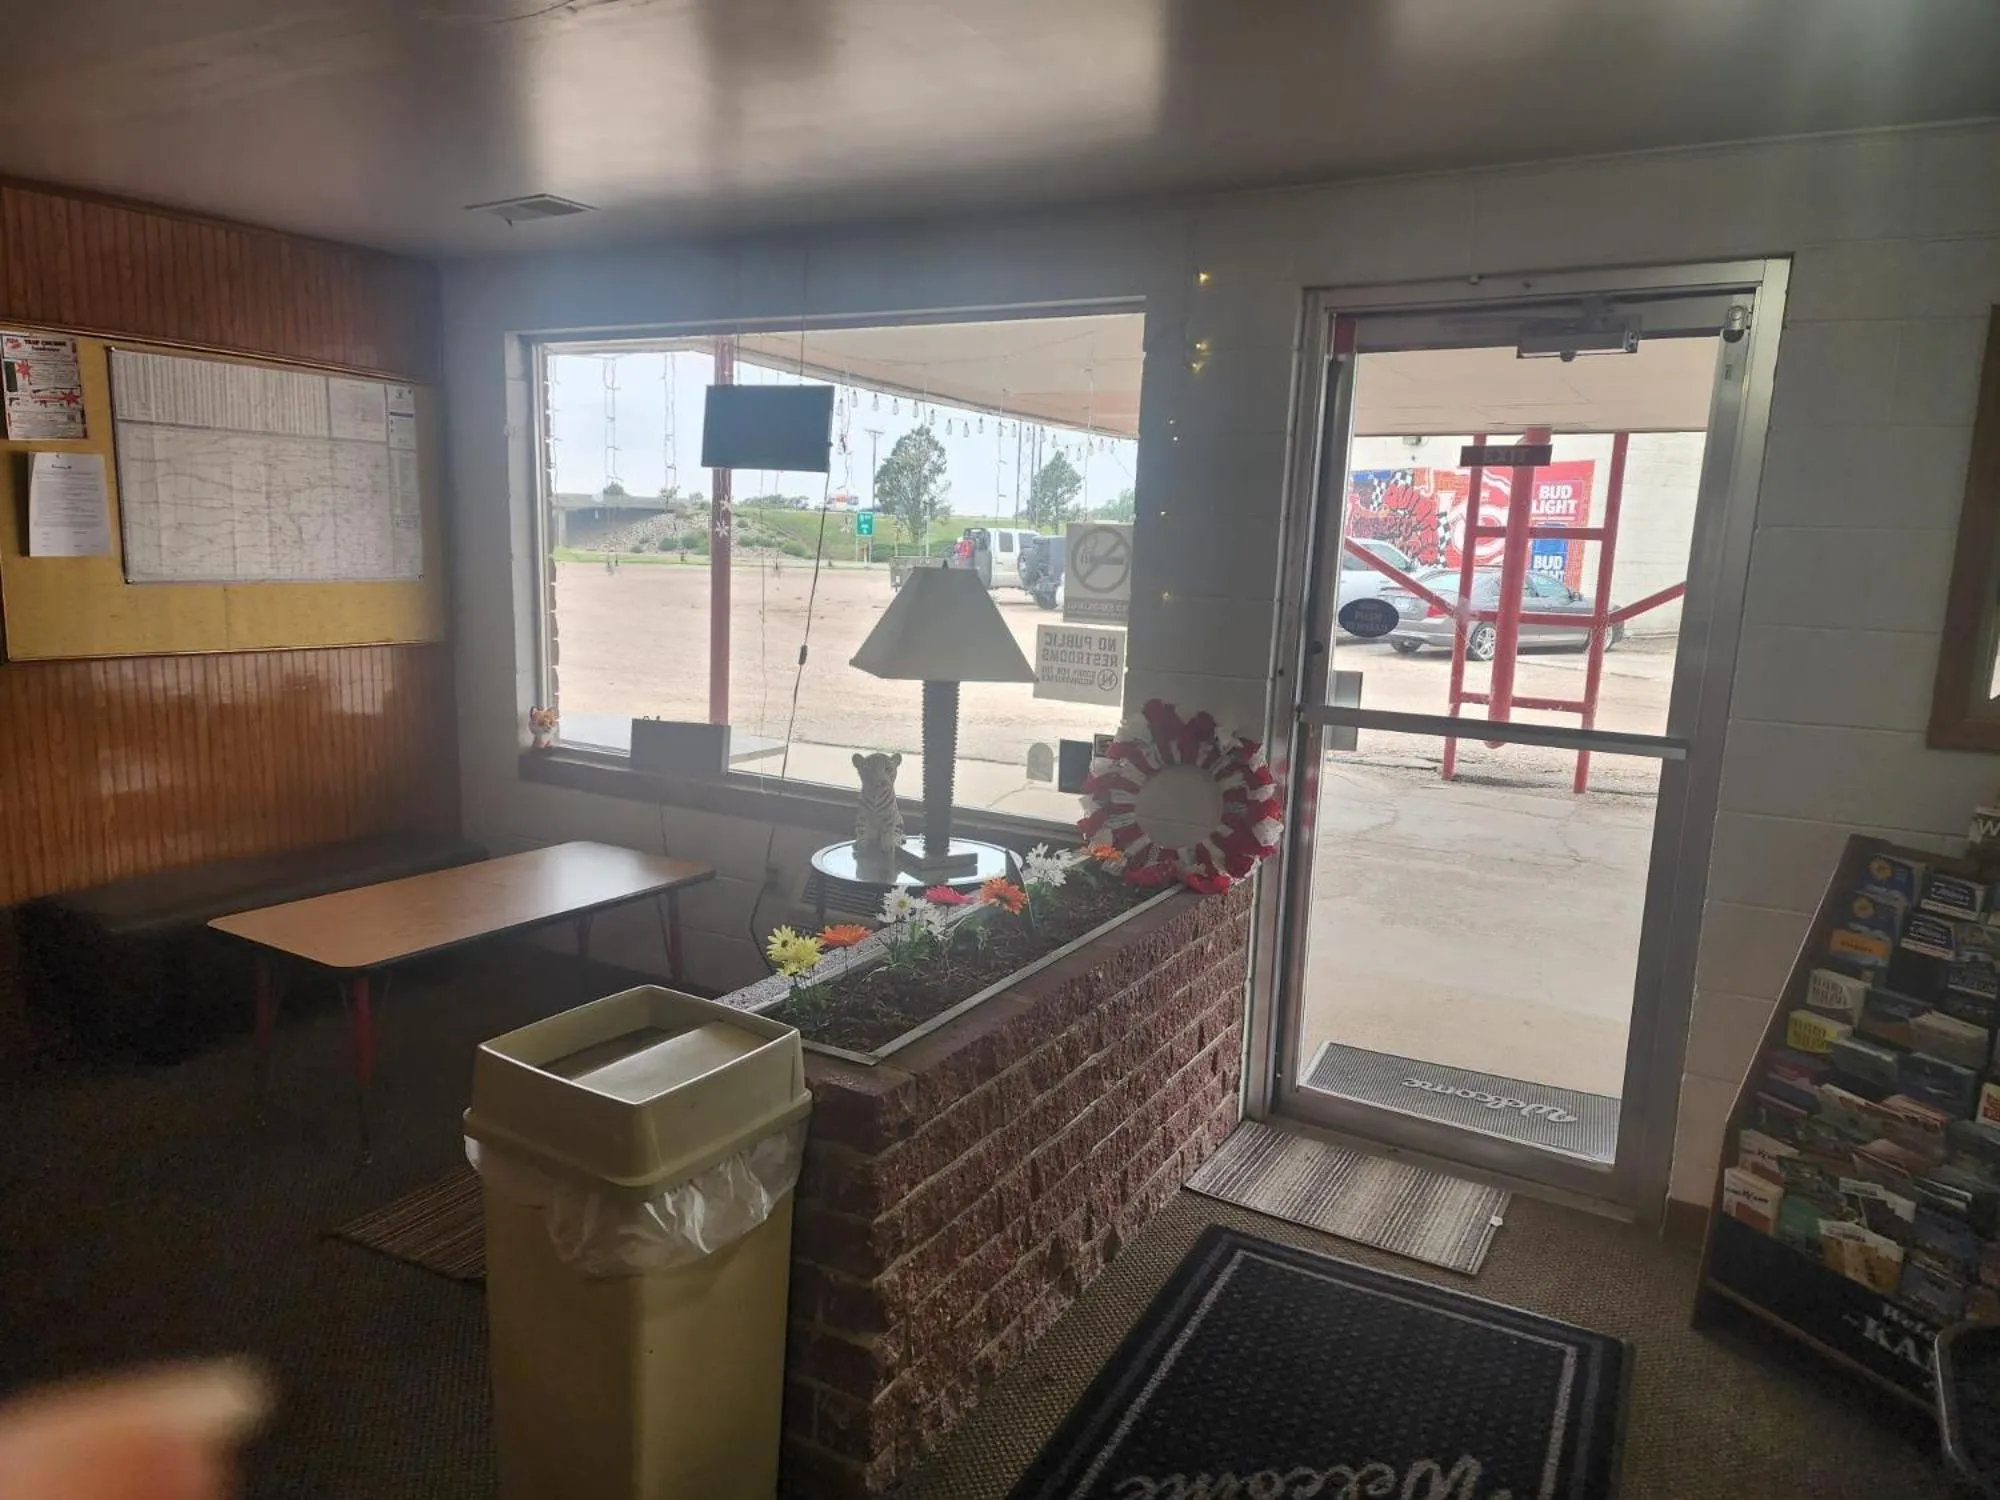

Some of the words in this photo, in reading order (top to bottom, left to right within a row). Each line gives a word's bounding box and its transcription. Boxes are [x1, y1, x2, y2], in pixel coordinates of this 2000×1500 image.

[1484, 447, 1530, 463] EXIT
[1539, 484, 1573, 500] BUD
[1531, 498, 1578, 515] LIGHT
[1532, 554, 1563, 570] BUD
[1400, 1077, 1578, 1124] Welcome
[1110, 1454, 1483, 1500] Welcome
